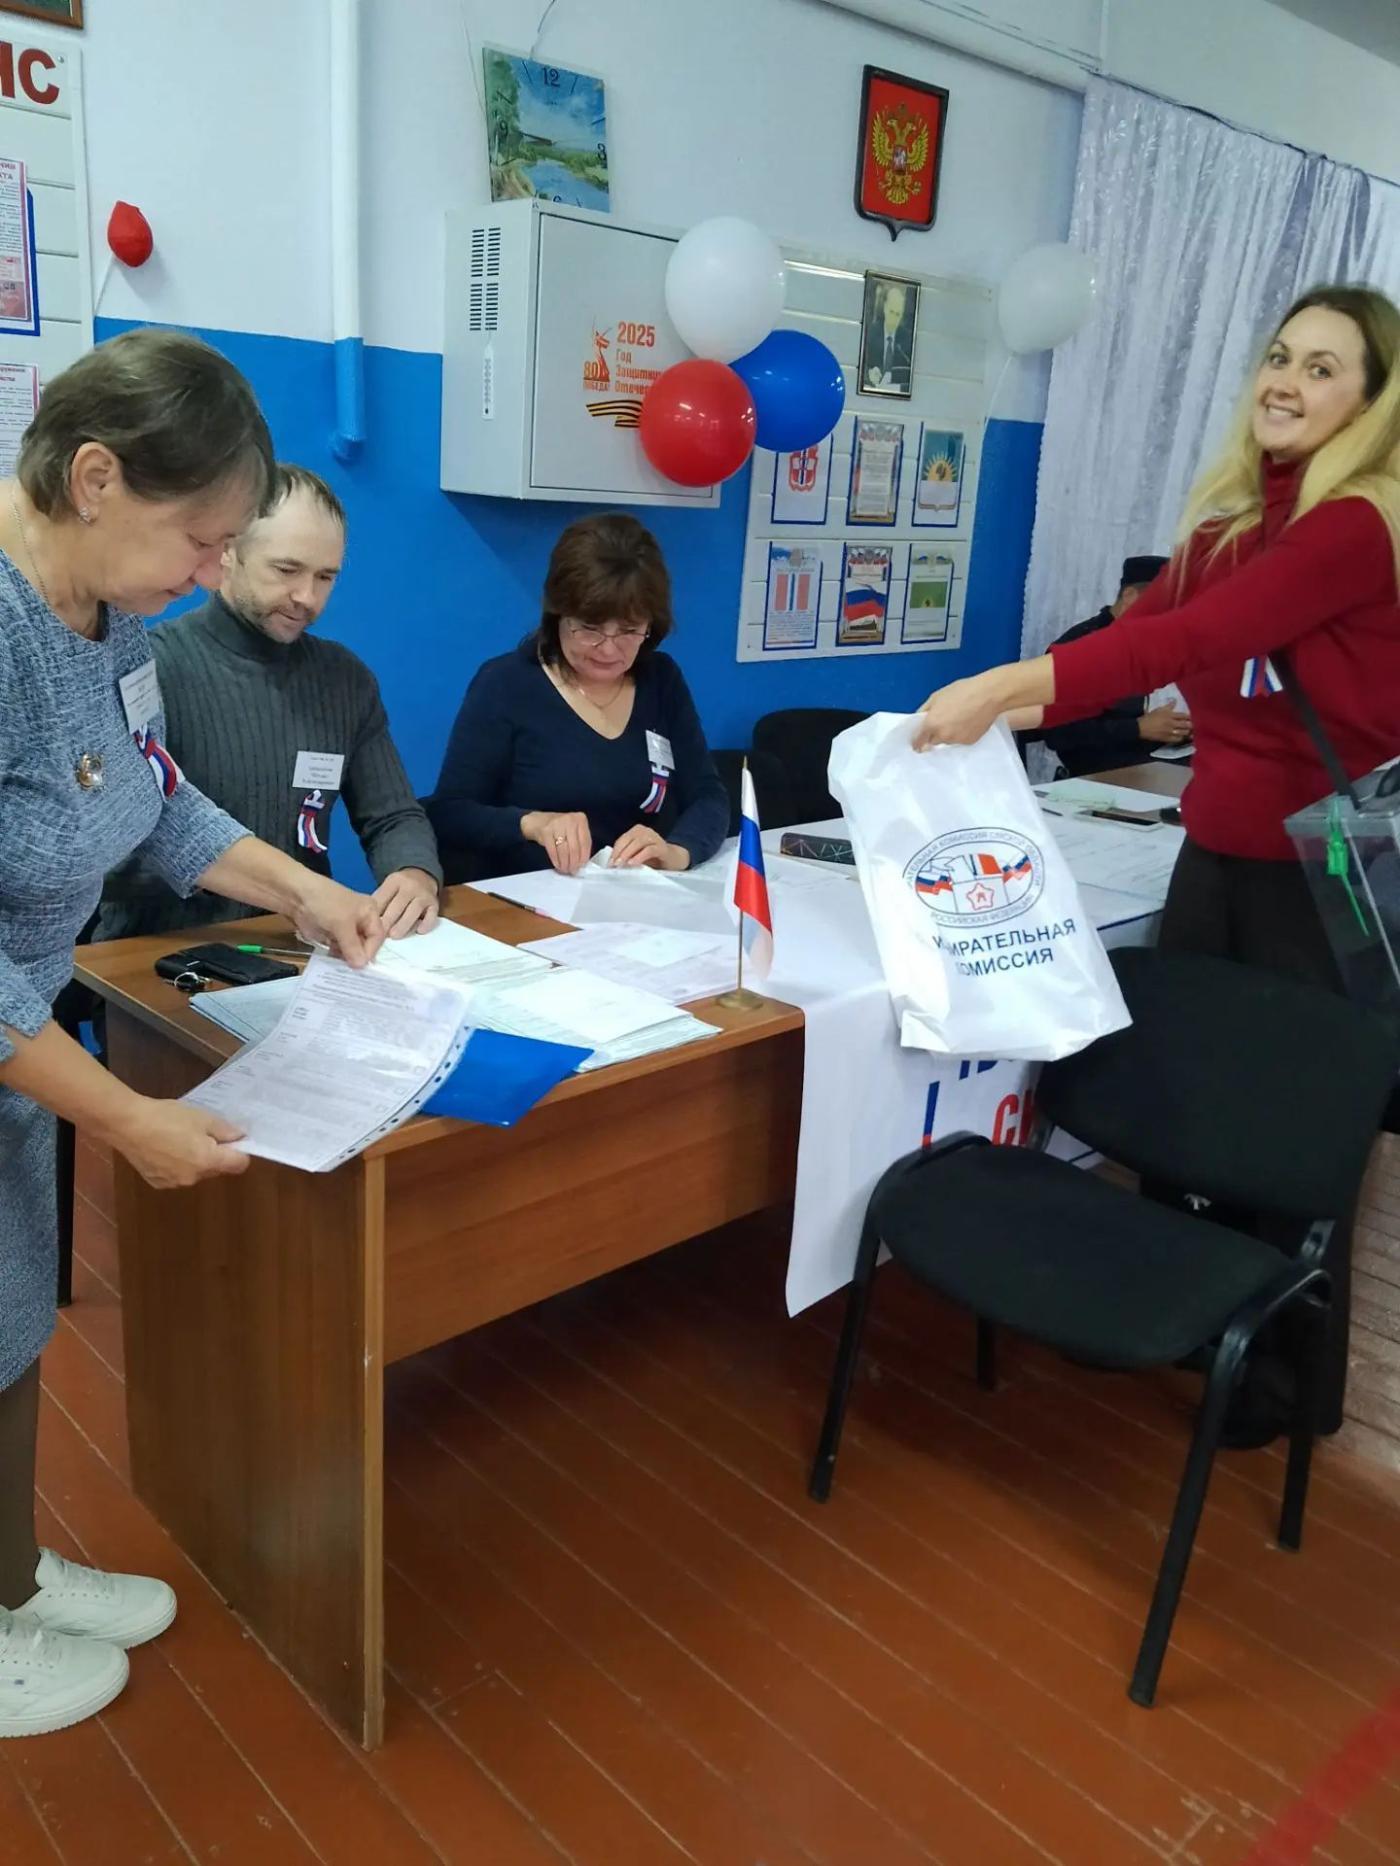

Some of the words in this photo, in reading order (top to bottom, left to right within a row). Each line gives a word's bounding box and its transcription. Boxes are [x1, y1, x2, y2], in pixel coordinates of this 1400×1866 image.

[542, 66, 561, 88] 12
[500, 119, 509, 138] 9
[617, 321, 656, 348] 2025
[616, 348, 632, 365] Год
[584, 360, 599, 379] 80
[932, 918, 1077, 958] ИИРАТЕЛЬНАЯ
[956, 948, 1055, 977] ОМИССИЯ
